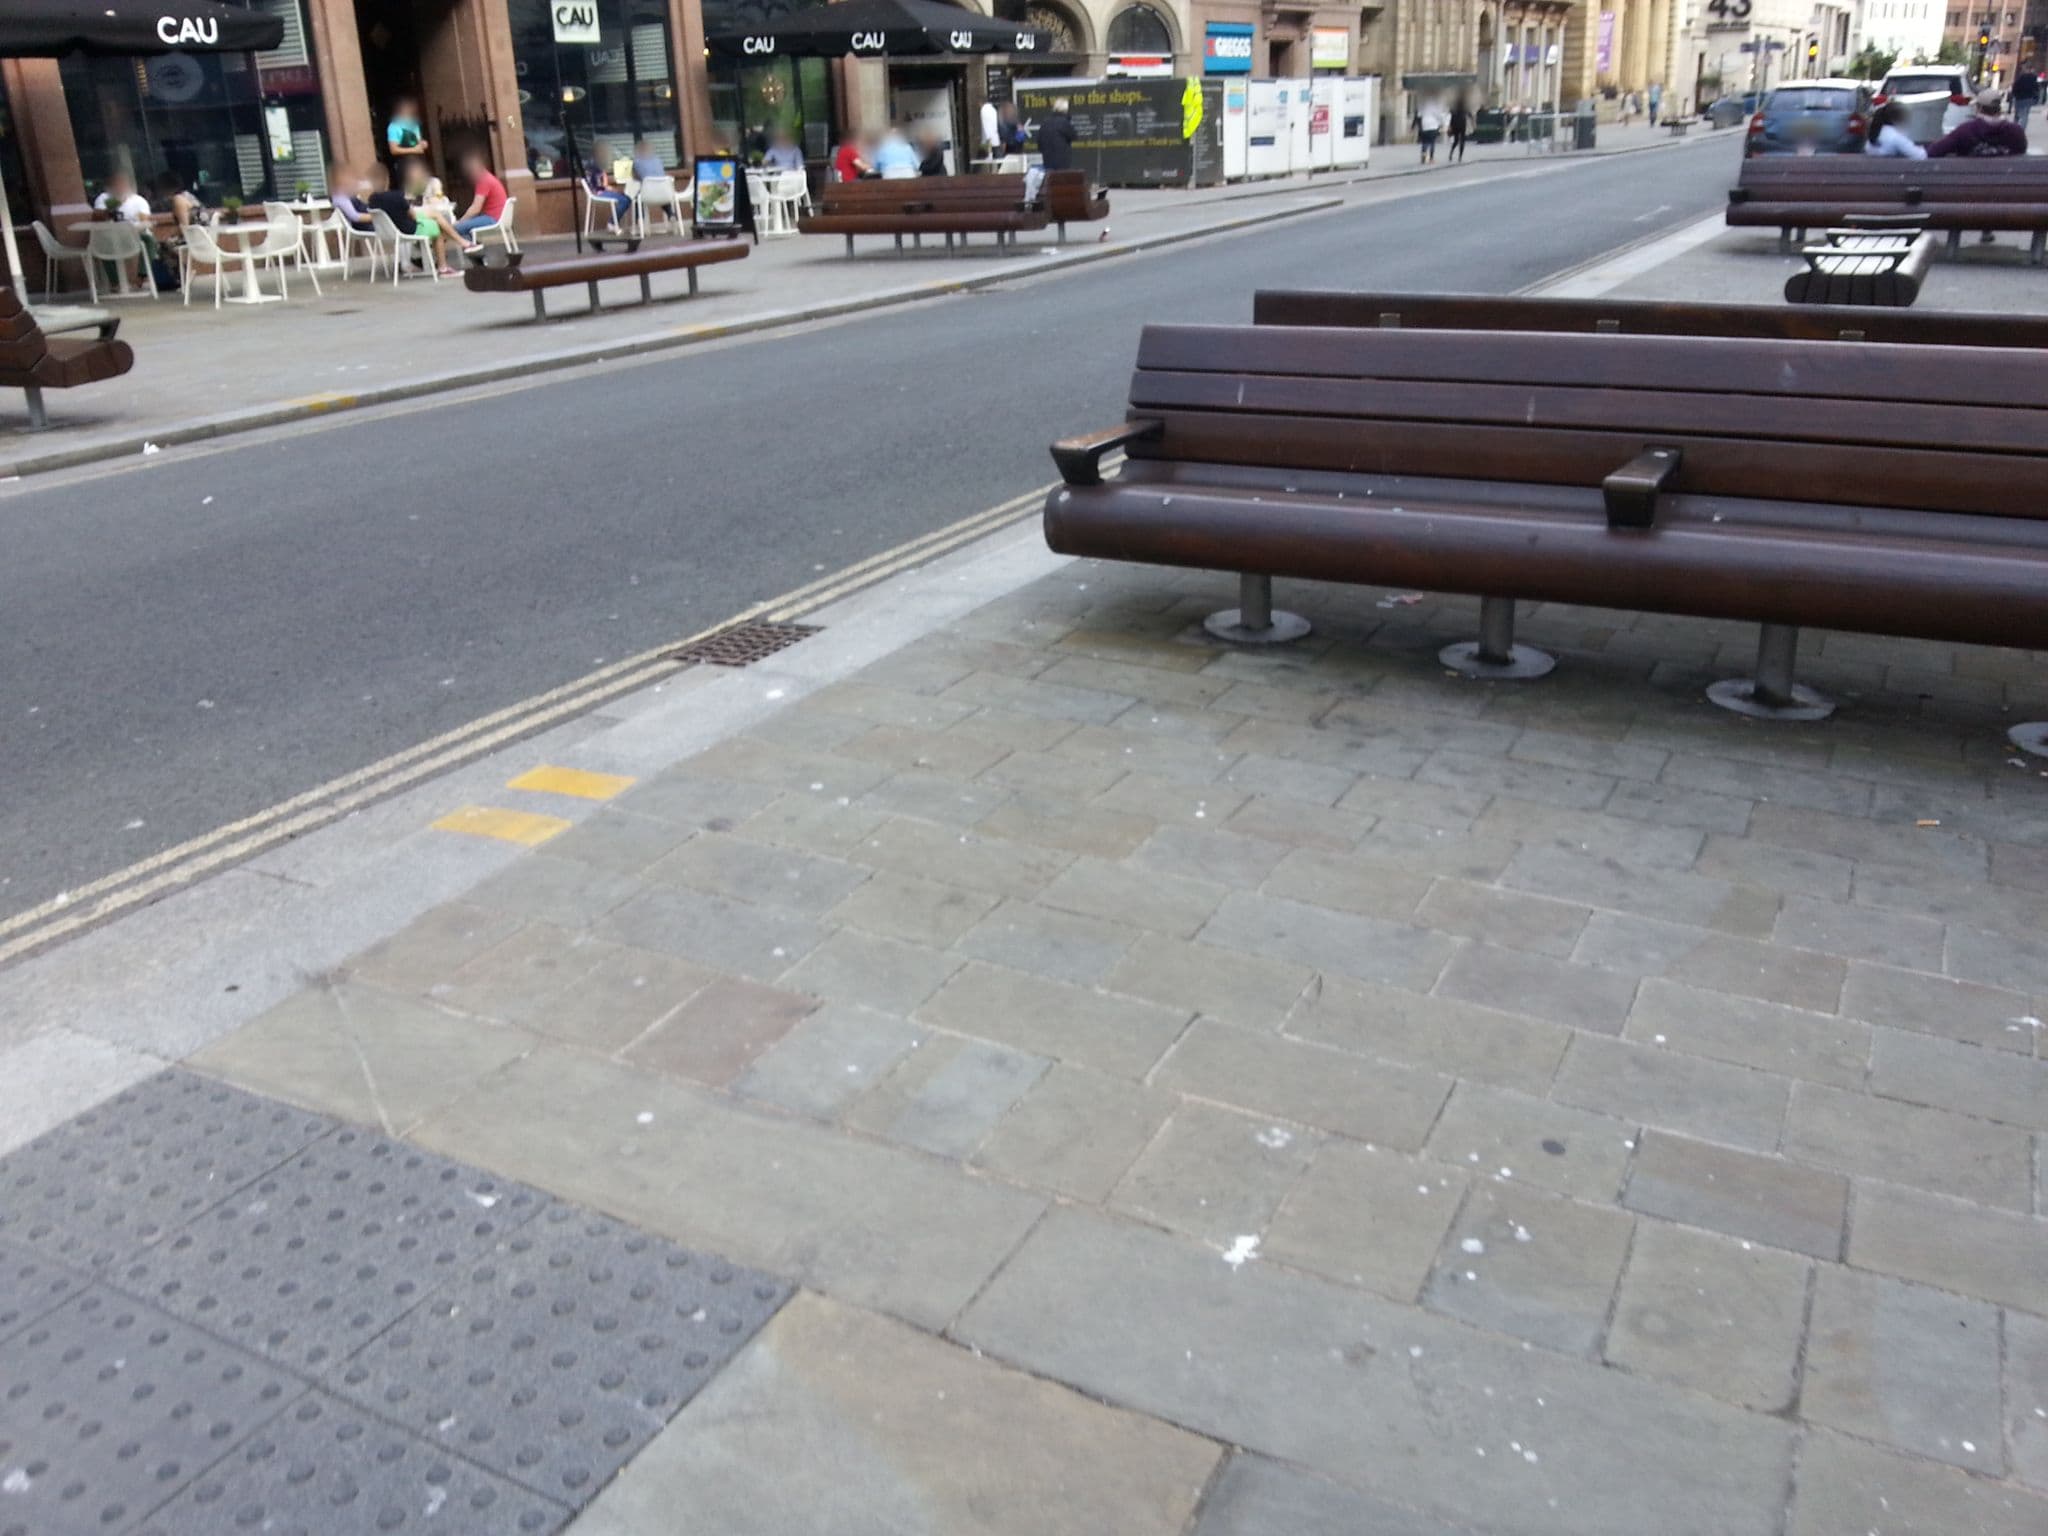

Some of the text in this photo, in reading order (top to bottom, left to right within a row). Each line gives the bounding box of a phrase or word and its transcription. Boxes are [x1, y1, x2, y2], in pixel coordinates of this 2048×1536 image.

[556, 6, 593, 26] CAU
[157, 16, 218, 44] CAU
[950, 31, 973, 48] CAU
[743, 37, 775, 54] CAU
[851, 32, 886, 50] CAU
[1015, 32, 1035, 50] CAU
[1215, 37, 1251, 57] GREGGS
[1022, 94, 1047, 109] This
[1073, 92, 1086, 105] to
[1087, 89, 1106, 105] the
